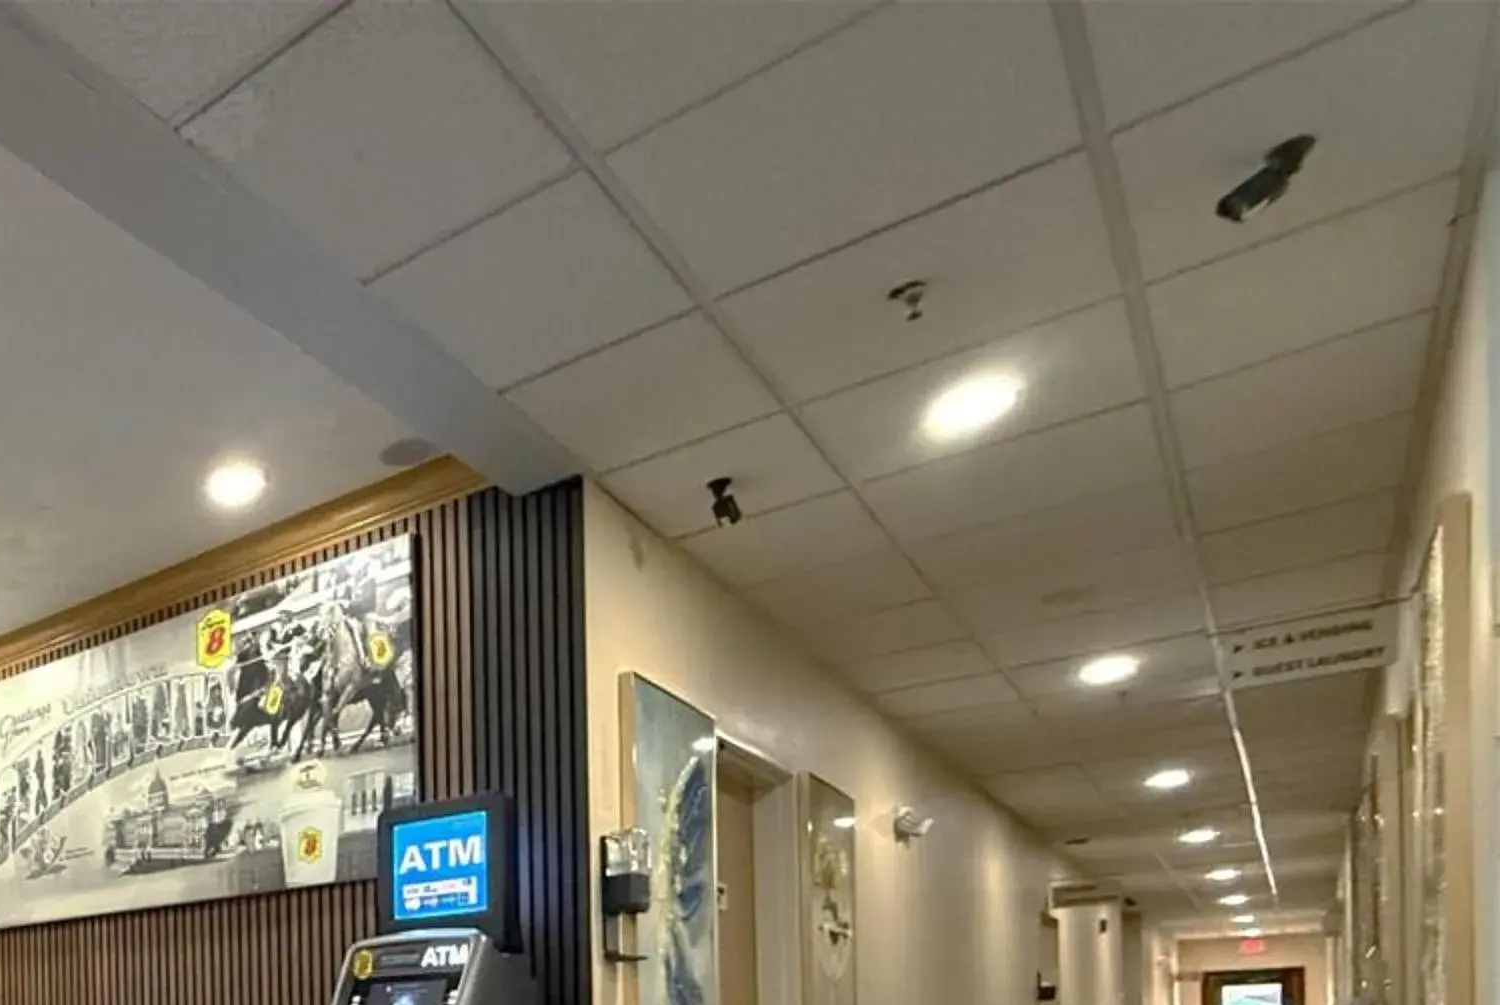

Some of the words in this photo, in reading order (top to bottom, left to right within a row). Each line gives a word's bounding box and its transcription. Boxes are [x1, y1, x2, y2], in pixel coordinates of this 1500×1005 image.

[205, 626, 227, 656] 8
[399, 834, 482, 875] ATM
[421, 943, 469, 969] ATM
